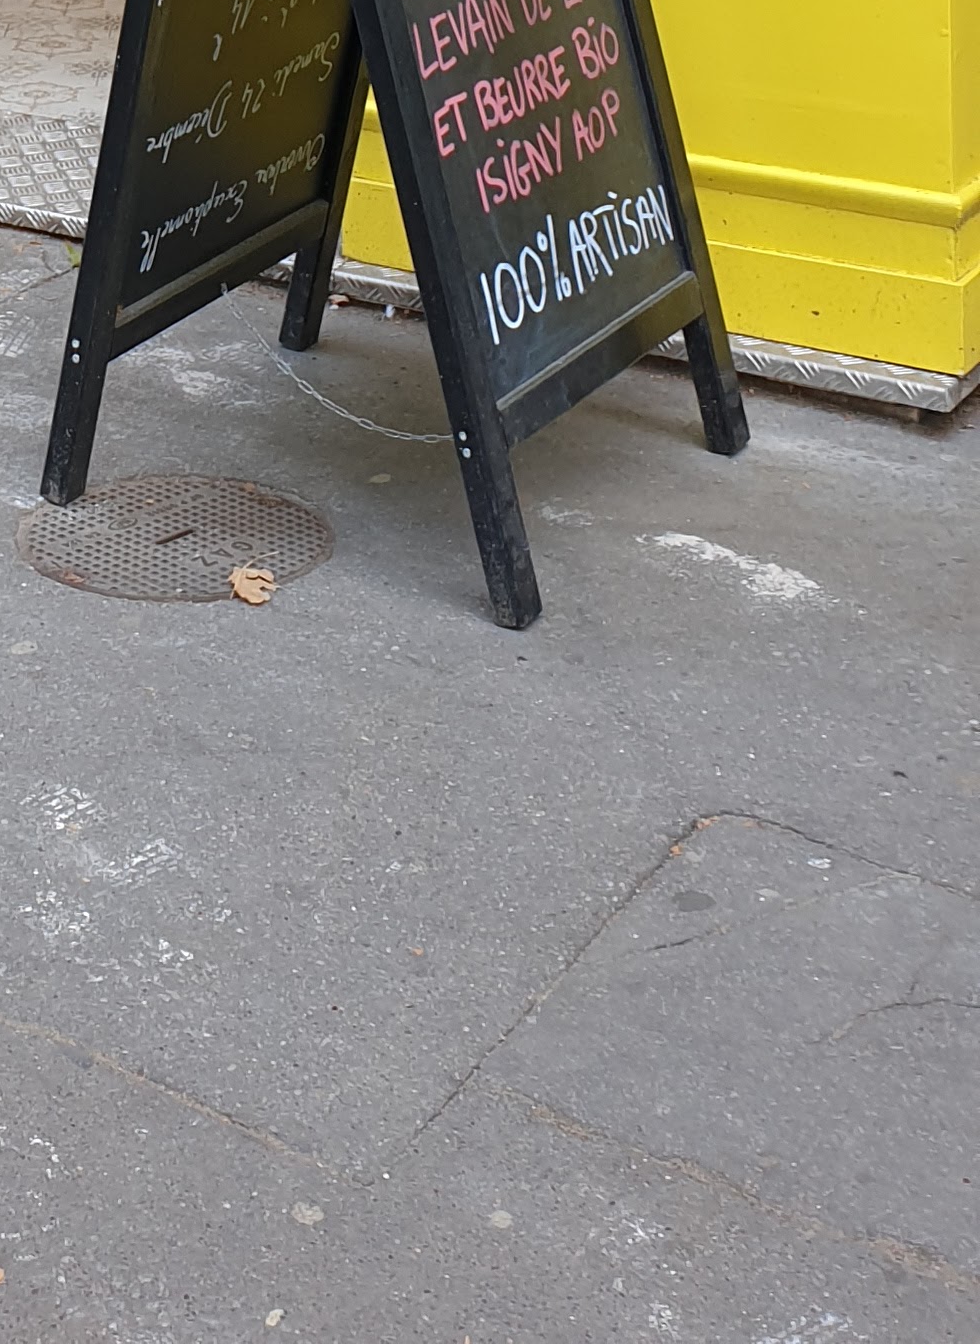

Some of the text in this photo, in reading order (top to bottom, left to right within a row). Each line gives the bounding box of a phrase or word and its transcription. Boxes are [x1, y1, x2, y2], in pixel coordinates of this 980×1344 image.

[146, 32, 340, 164] Samedi 24 Décembre
[433, 16, 619, 157] ET BEURRE BIO
[476, 87, 620, 212] ISIGNY AOP
[480, 184, 673, 345] 100% ARTISAN
[191, 540, 254, 567] GAZ
